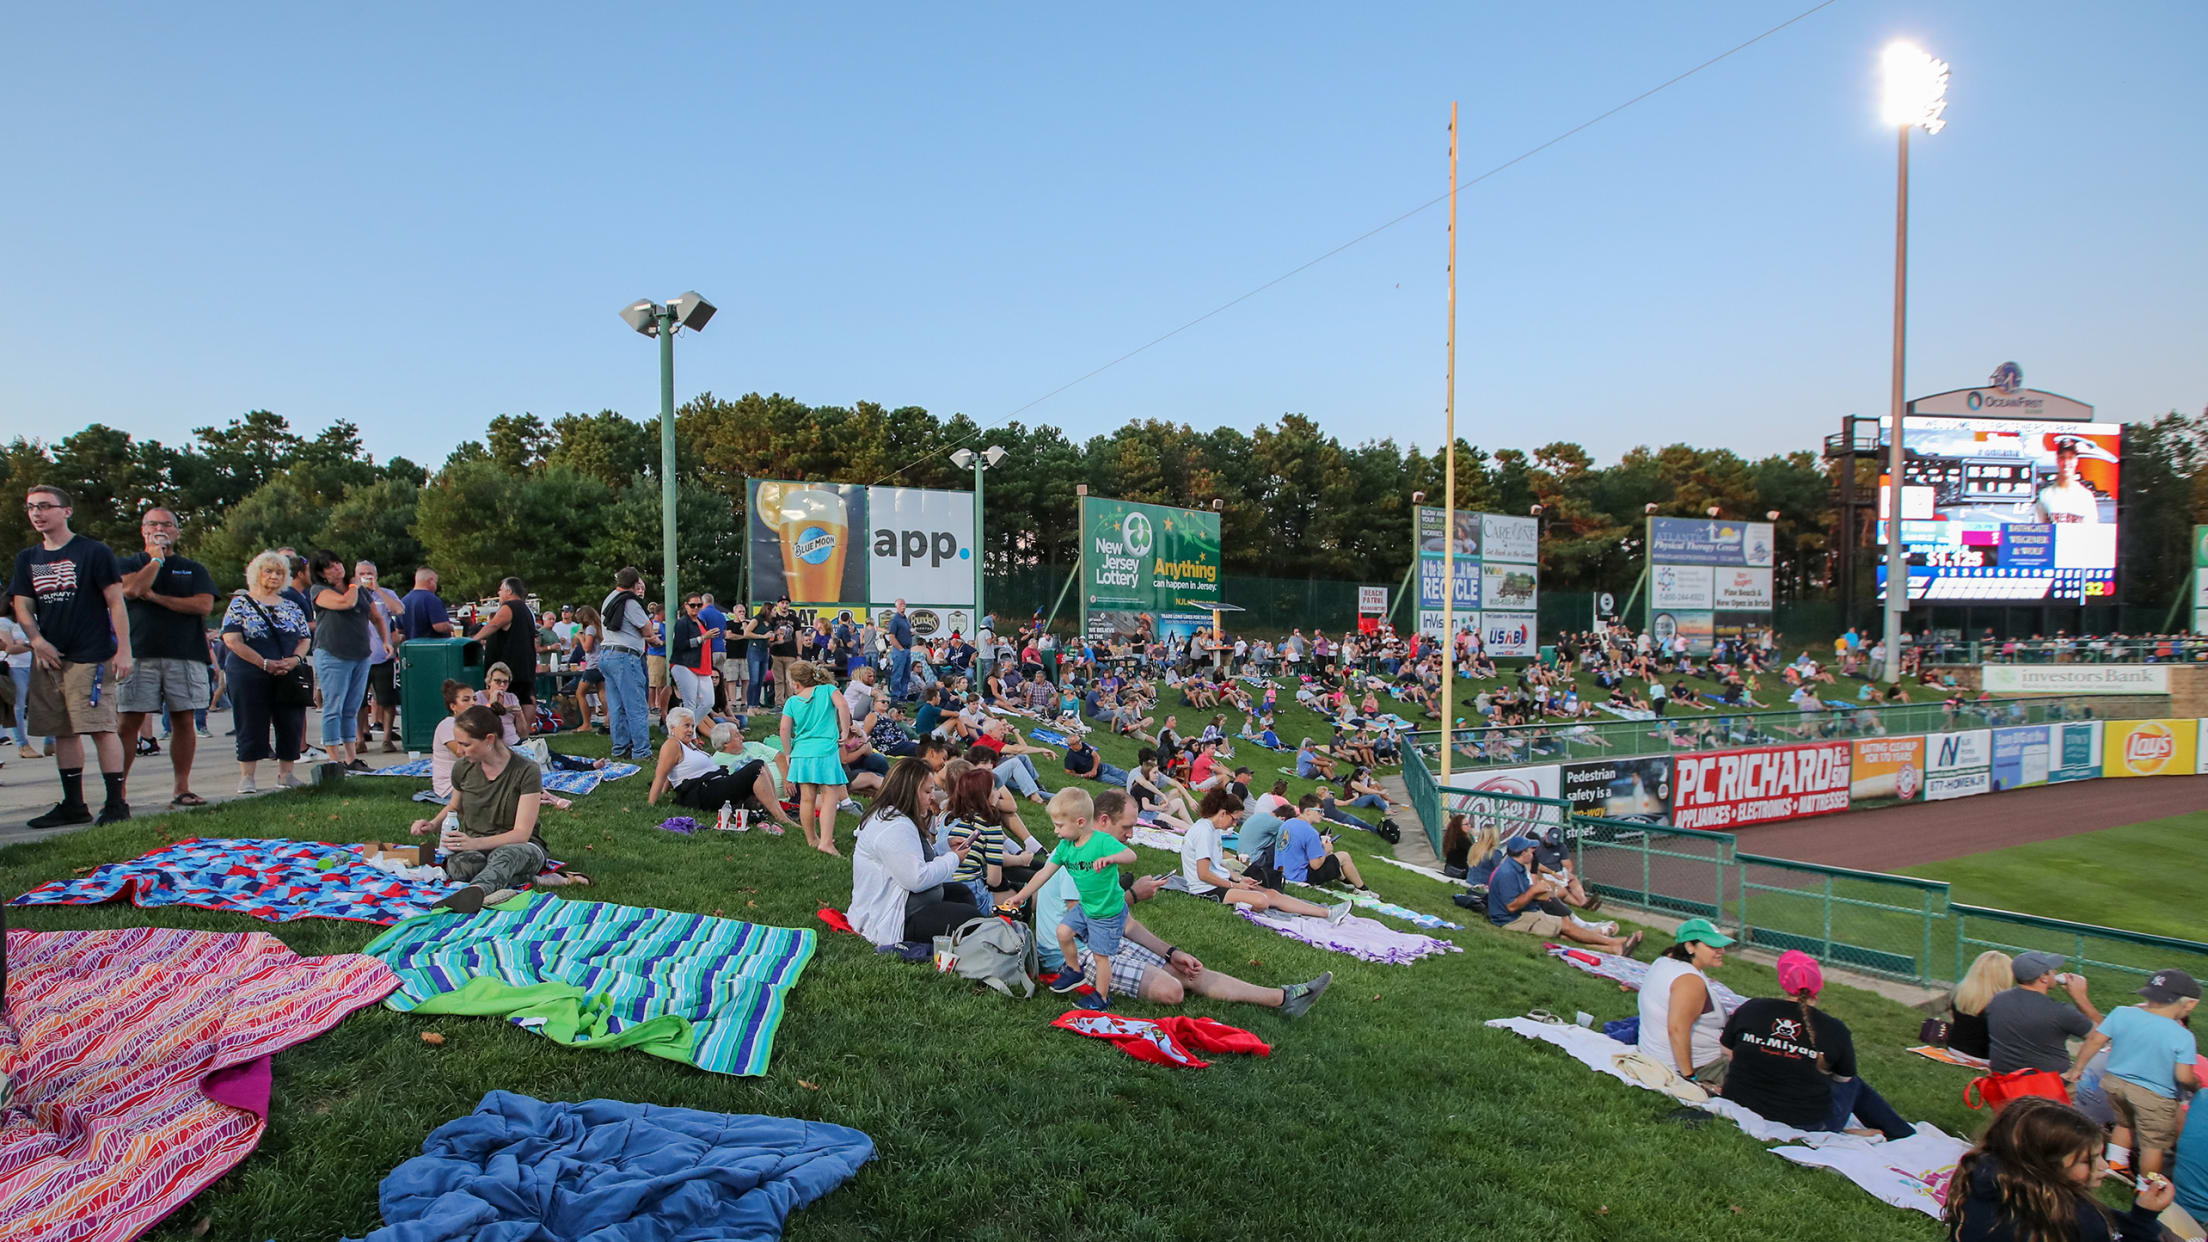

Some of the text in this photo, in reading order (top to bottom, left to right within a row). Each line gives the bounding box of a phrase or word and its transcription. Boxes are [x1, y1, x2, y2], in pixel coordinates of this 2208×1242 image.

[795, 535, 835, 557] BLUE MOON
[874, 529, 970, 568] app.
[1096, 537, 1124, 554] New
[1102, 554, 1139, 574] Jersey
[1153, 557, 1217, 583] Anything
[1096, 568, 1139, 588] Lottery
[1153, 579, 1165, 588] can
[1165, 579, 1189, 590] happen
[1190, 580, 1197, 589] in
[1362, 596, 1384, 604] PATROL
[1423, 613, 1458, 629] InVisn
[2129, 733, 2171, 760] Lay's
[1567, 768, 1616, 784] Pedestrian
[1830, 765, 1850, 788] SON
[1566, 787, 1612, 803] safety is a
[1674, 790, 1849, 829] APPLIANCES ELECTRONICS MATTRESSES
[1742, 1032, 1825, 1060] Mr.Miyag
